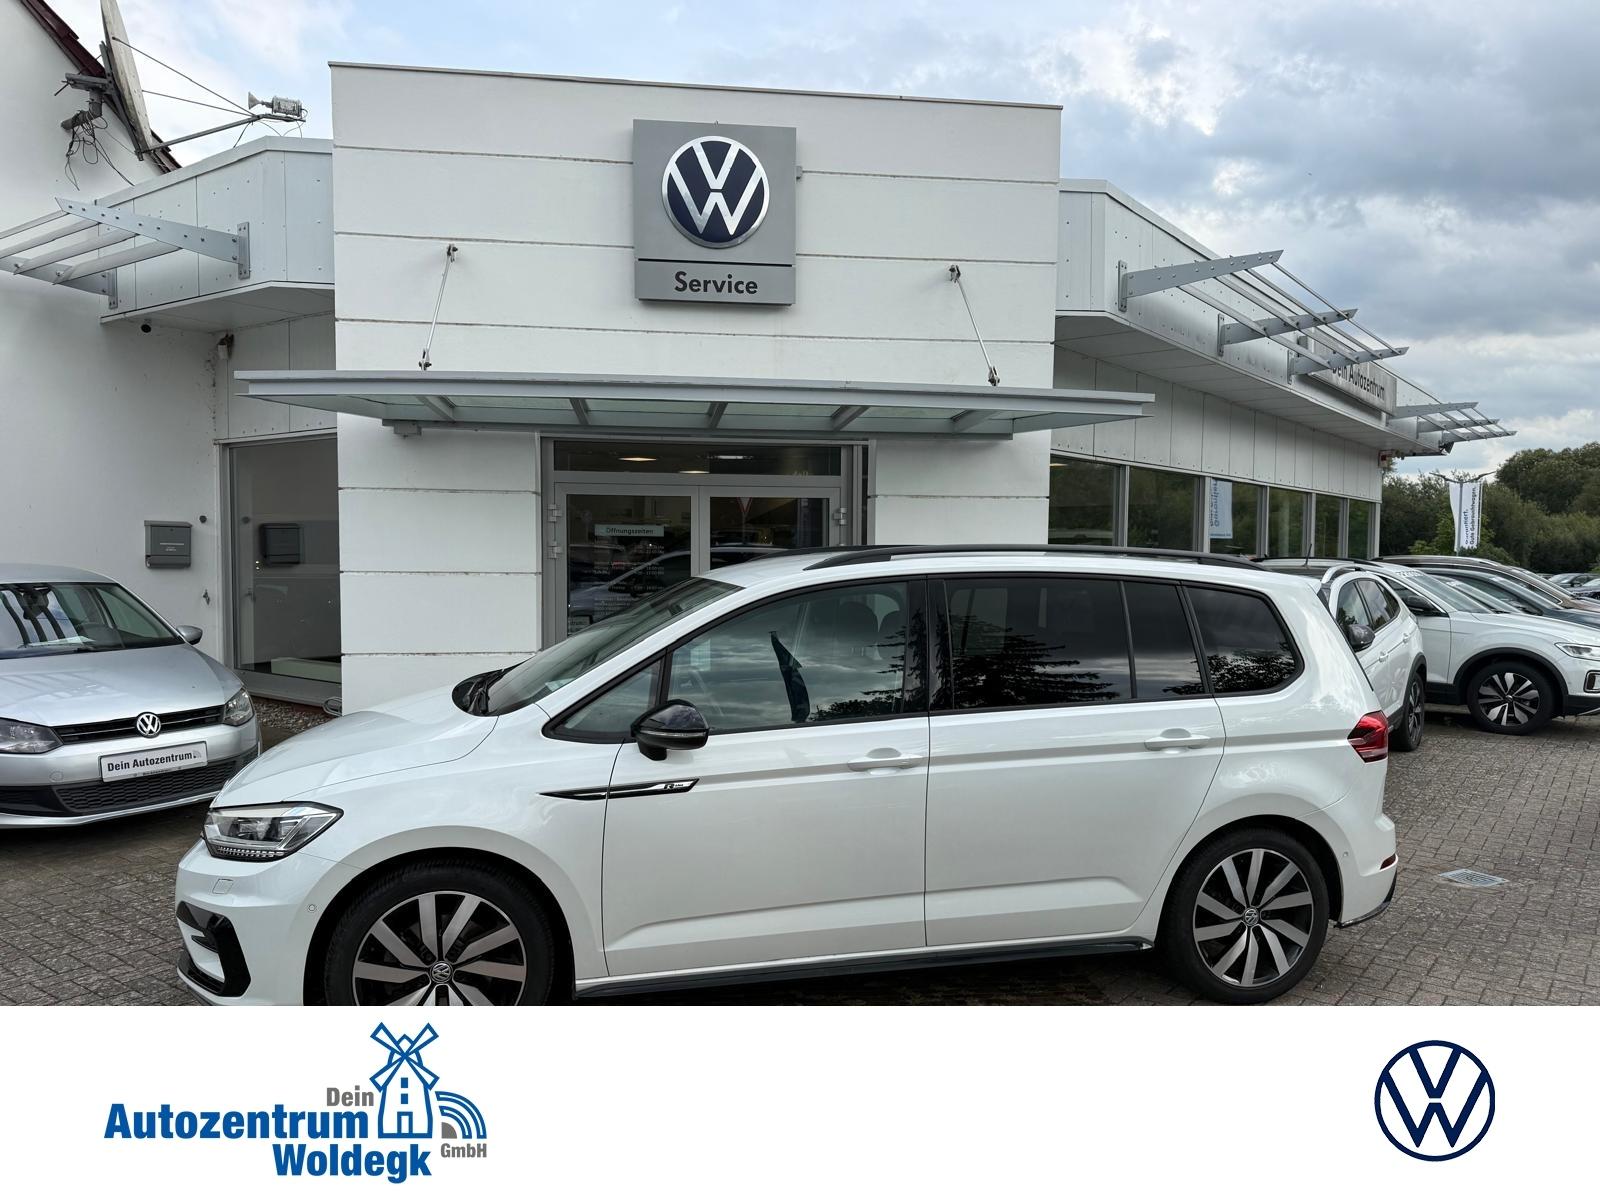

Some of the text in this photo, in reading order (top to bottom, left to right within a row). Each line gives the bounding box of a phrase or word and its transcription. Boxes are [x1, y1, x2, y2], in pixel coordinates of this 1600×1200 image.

[674, 270, 758, 295] Service
[1349, 363, 1385, 400] Autozentrum
[606, 526, 654, 537] Öffnungszeiten
[107, 761, 130, 772] Dein
